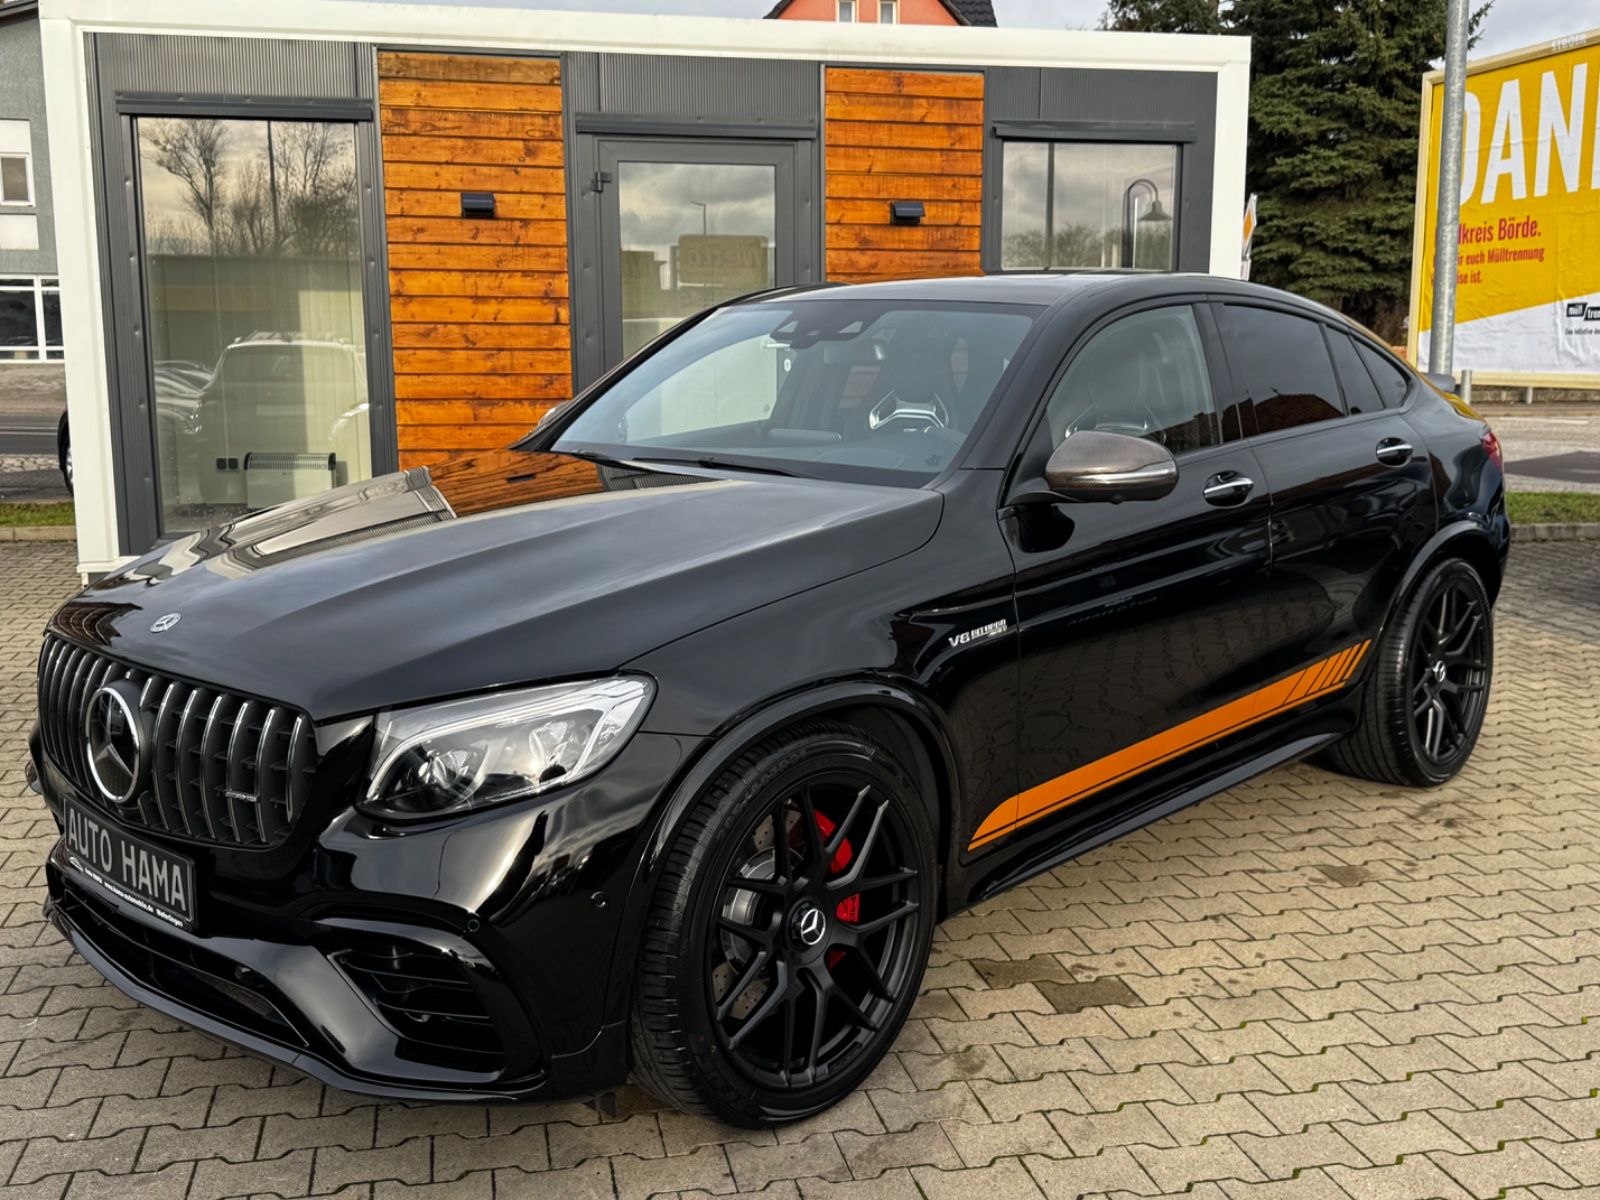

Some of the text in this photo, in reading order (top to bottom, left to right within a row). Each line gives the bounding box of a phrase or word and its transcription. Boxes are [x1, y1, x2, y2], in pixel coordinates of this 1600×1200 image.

[1459, 63, 1600, 206] DAN
[1498, 215, 1541, 241] Börde.
[1466, 250, 1485, 266] euch
[1487, 247, 1545, 263] Mülltrennung
[948, 631, 971, 648] V8
[68, 808, 186, 911] AUTO HAMA
